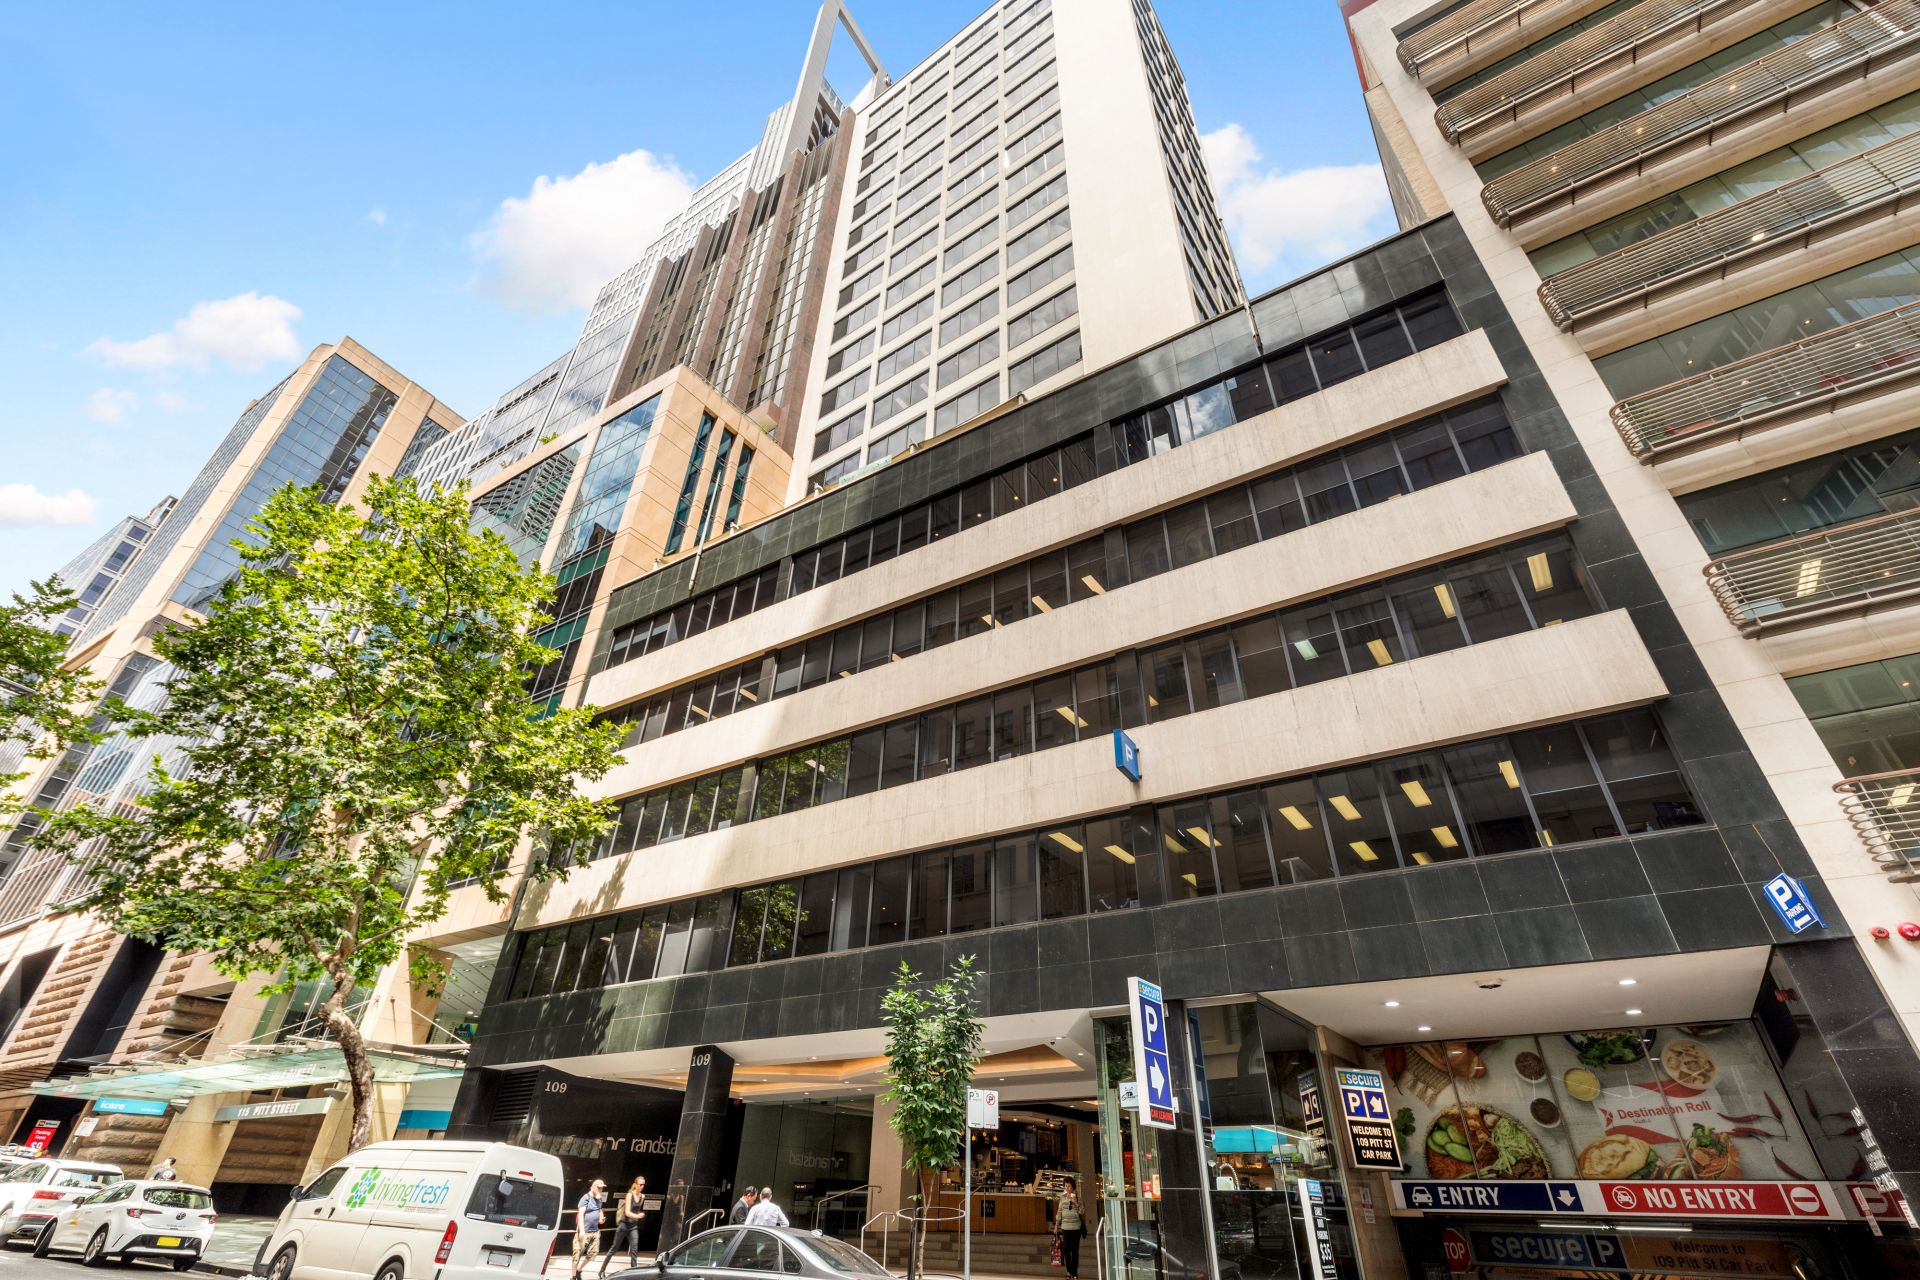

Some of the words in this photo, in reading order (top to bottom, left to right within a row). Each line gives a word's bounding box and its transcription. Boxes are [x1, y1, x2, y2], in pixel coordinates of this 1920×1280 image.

[1125, 744, 1133, 761] P
[1768, 879, 1793, 911] P
[1785, 903, 1805, 919] PARKING
[1142, 984, 1160, 1000] secure
[1145, 1004, 1158, 1043] P
[691, 1053, 711, 1067] 109
[544, 1081, 567, 1094] 109
[1346, 1073, 1380, 1087] secure
[100, 1100, 126, 1110] icare
[252, 1104, 271, 1116] PITT
[270, 1103, 300, 1115] STREET
[1347, 1092, 1361, 1113] P
[1684, 1101, 1712, 1113] Roll
[1351, 1125, 1382, 1137] WELCOME
[1382, 1127, 1392, 1137] TO
[630, 1135, 678, 1154] randsta
[1356, 1137, 1369, 1147] 109
[1369, 1138, 1384, 1148] PITT
[1384, 1139, 1393, 1149] ST
[1361, 1149, 1375, 1159] CAR
[1375, 1150, 1393, 1160] PARK
[372, 1177, 450, 1208] livingfresh
[1438, 1186, 1499, 1206] ENTRY
[1643, 1187, 1677, 1208] NO
[1679, 1188, 1757, 1210] ENTRY
[1443, 1241, 1465, 1260] TOP
[1491, 1236, 1584, 1262] secure
[1596, 1239, 1615, 1264] P
[1670, 1241, 1729, 1254] Welcome
[1731, 1243, 1746, 1255] to
[1653, 1255, 1676, 1268] 109
[1679, 1256, 1700, 1269] Pitt
[1703, 1258, 1718, 1270] St
[1720, 1258, 1741, 1271] Car
[1746, 1260, 1777, 1273] Park
